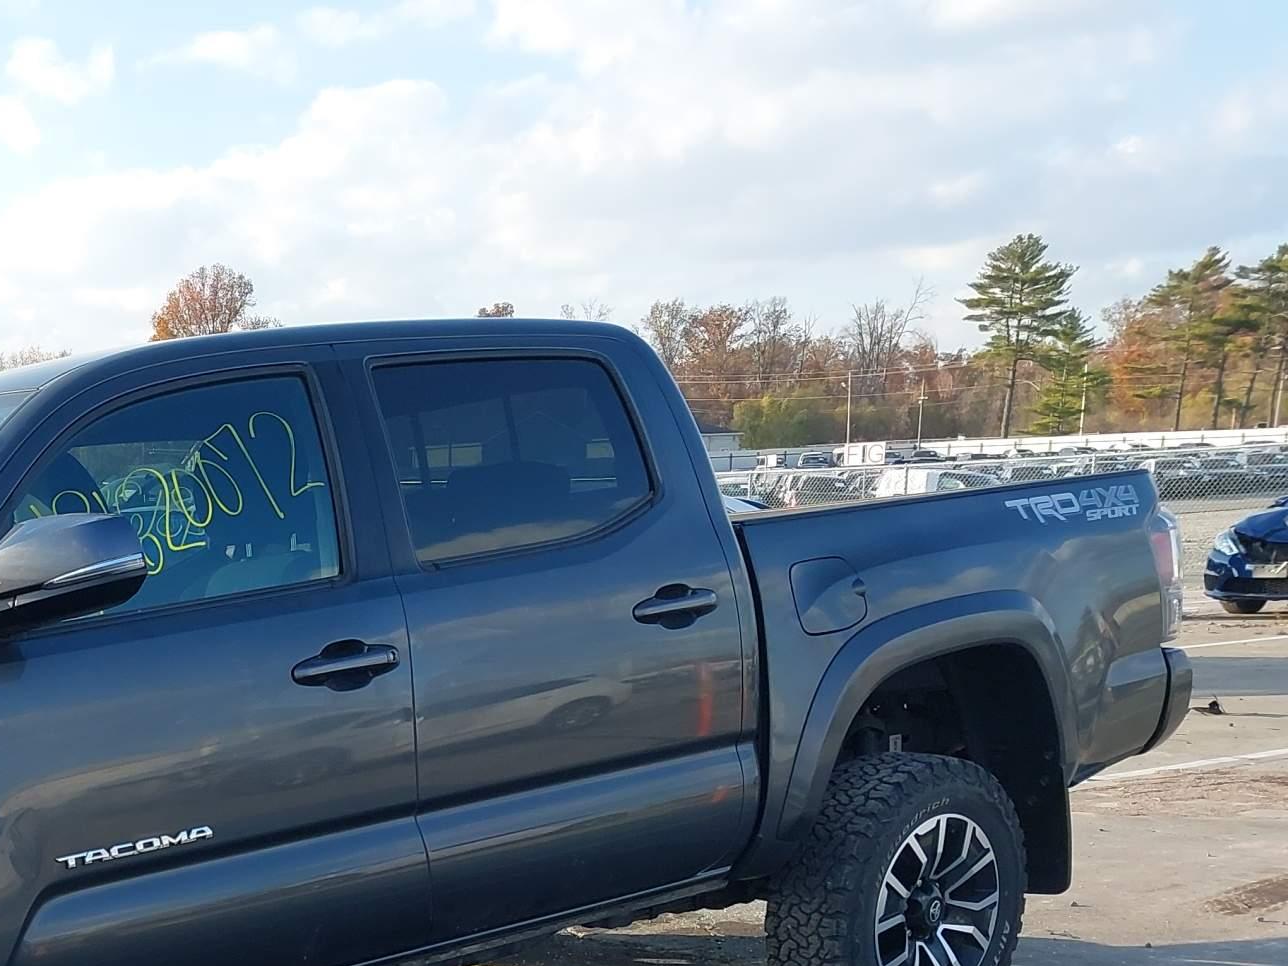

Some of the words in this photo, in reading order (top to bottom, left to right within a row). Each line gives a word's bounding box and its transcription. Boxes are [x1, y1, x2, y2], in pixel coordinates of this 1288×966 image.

[1004, 492, 1081, 524] TRD
[1078, 484, 1139, 508] 4X4
[1085, 503, 1140, 522] SPORT
[55, 825, 214, 869] TACOMA
